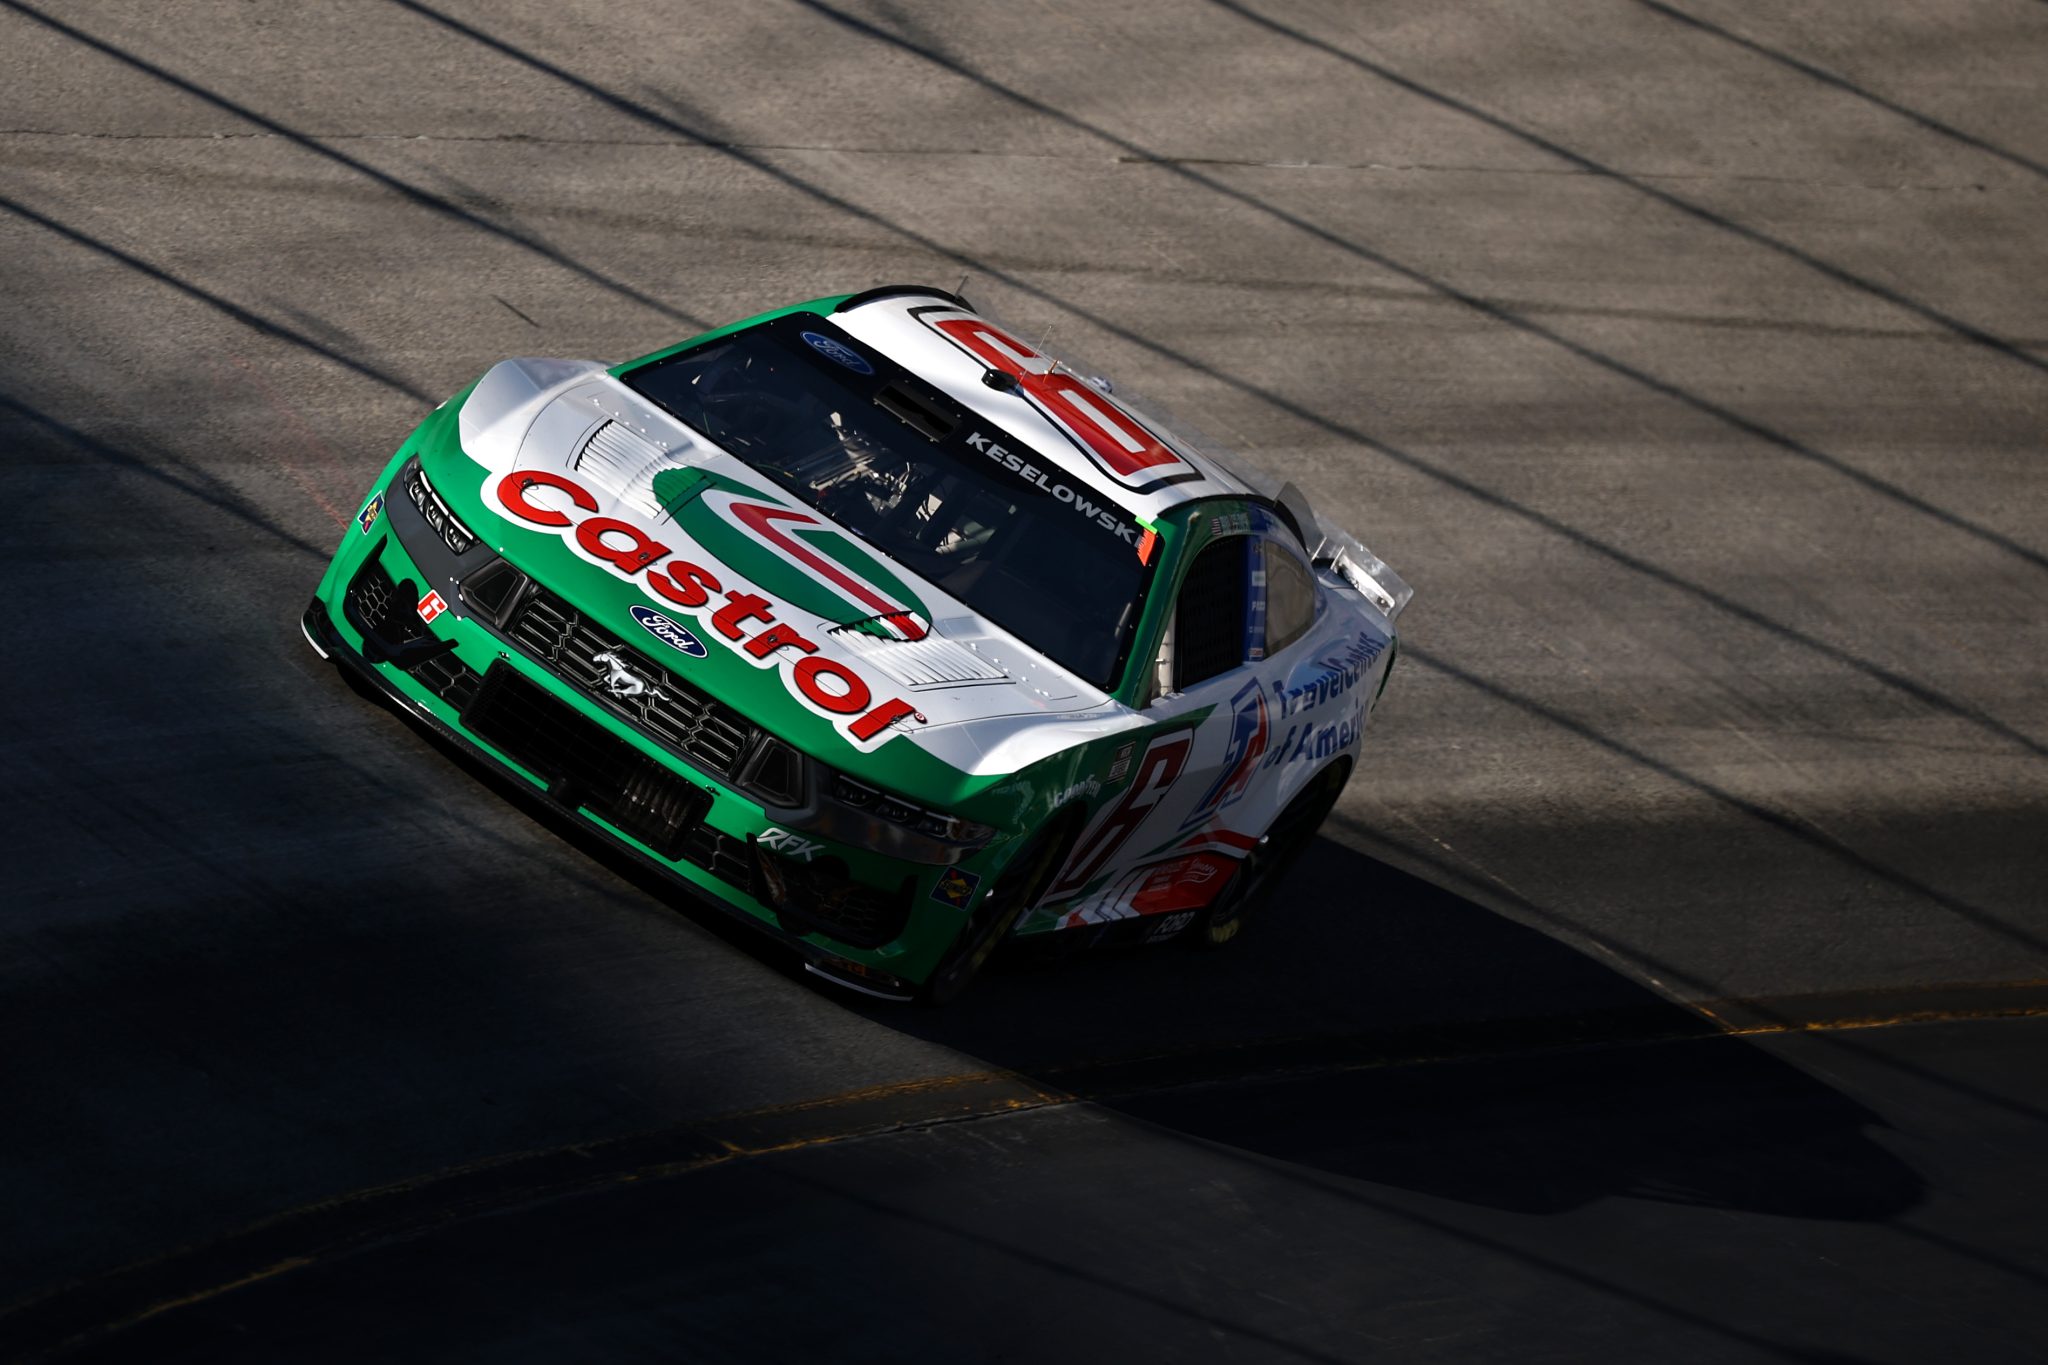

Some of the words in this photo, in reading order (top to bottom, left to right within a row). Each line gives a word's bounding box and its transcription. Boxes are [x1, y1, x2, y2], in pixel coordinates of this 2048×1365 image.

[965, 431, 1147, 549] KESELOWSKI
[417, 590, 447, 624] 6
[496, 469, 915, 742] Castrol
[641, 614, 696, 650] Ford
[1263, 725, 1298, 770] of
[1048, 738, 1193, 896] 6
[757, 827, 826, 863] RFK
